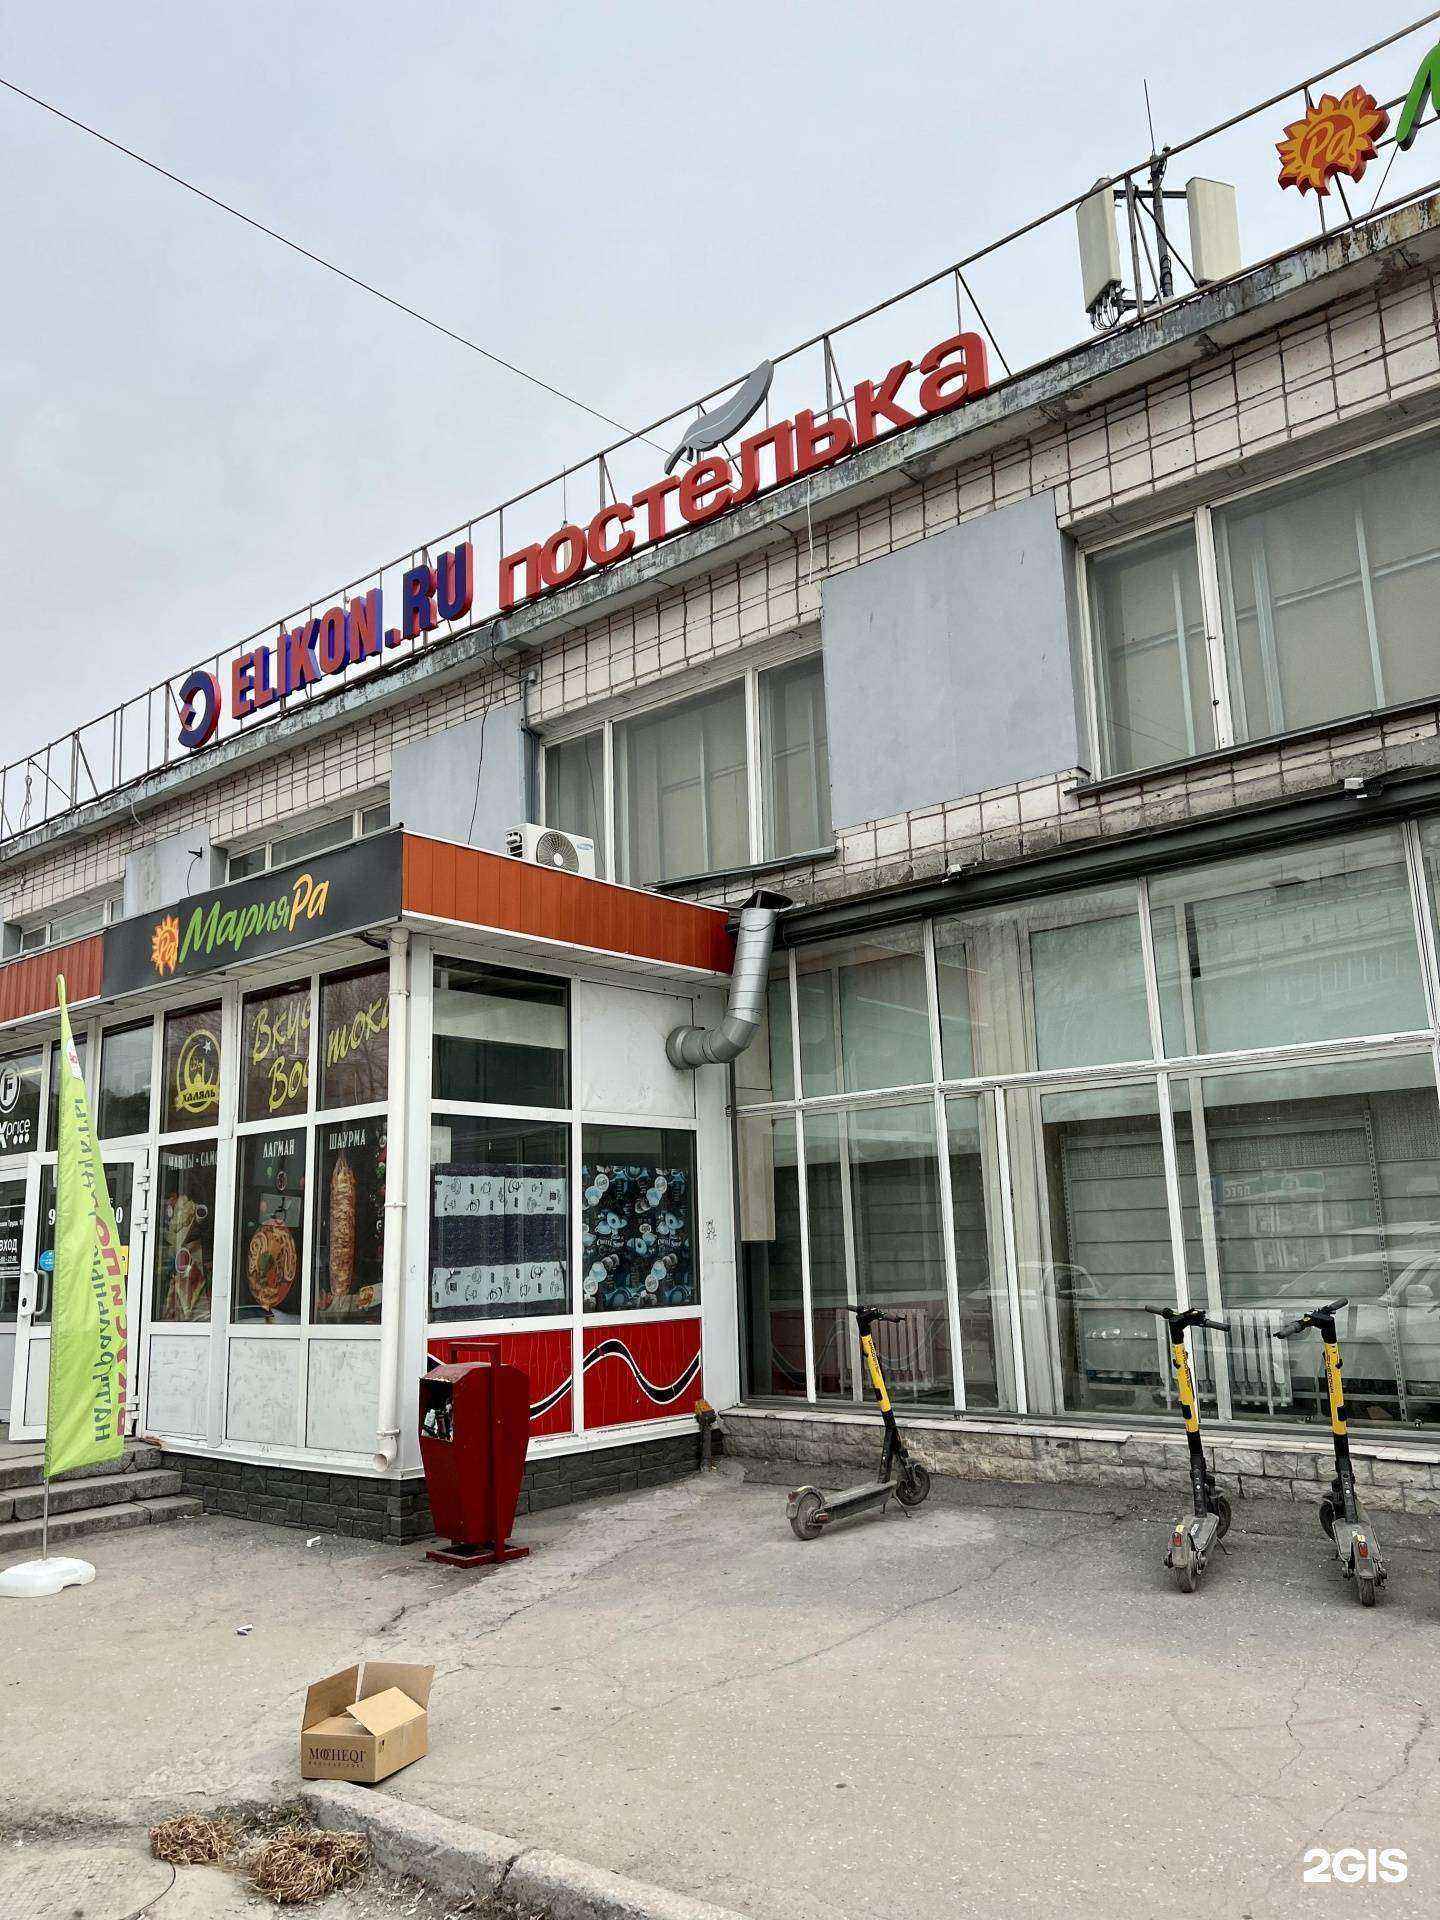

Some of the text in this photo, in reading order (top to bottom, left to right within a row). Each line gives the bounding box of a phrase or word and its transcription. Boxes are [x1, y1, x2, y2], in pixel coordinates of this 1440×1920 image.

[498, 331, 990, 611] постелька
[231, 541, 474, 720] ELIKON.RU
[262, 1138, 295, 1159] ЛАГМАН
[329, 1129, 367, 1150] ШАУРМА
